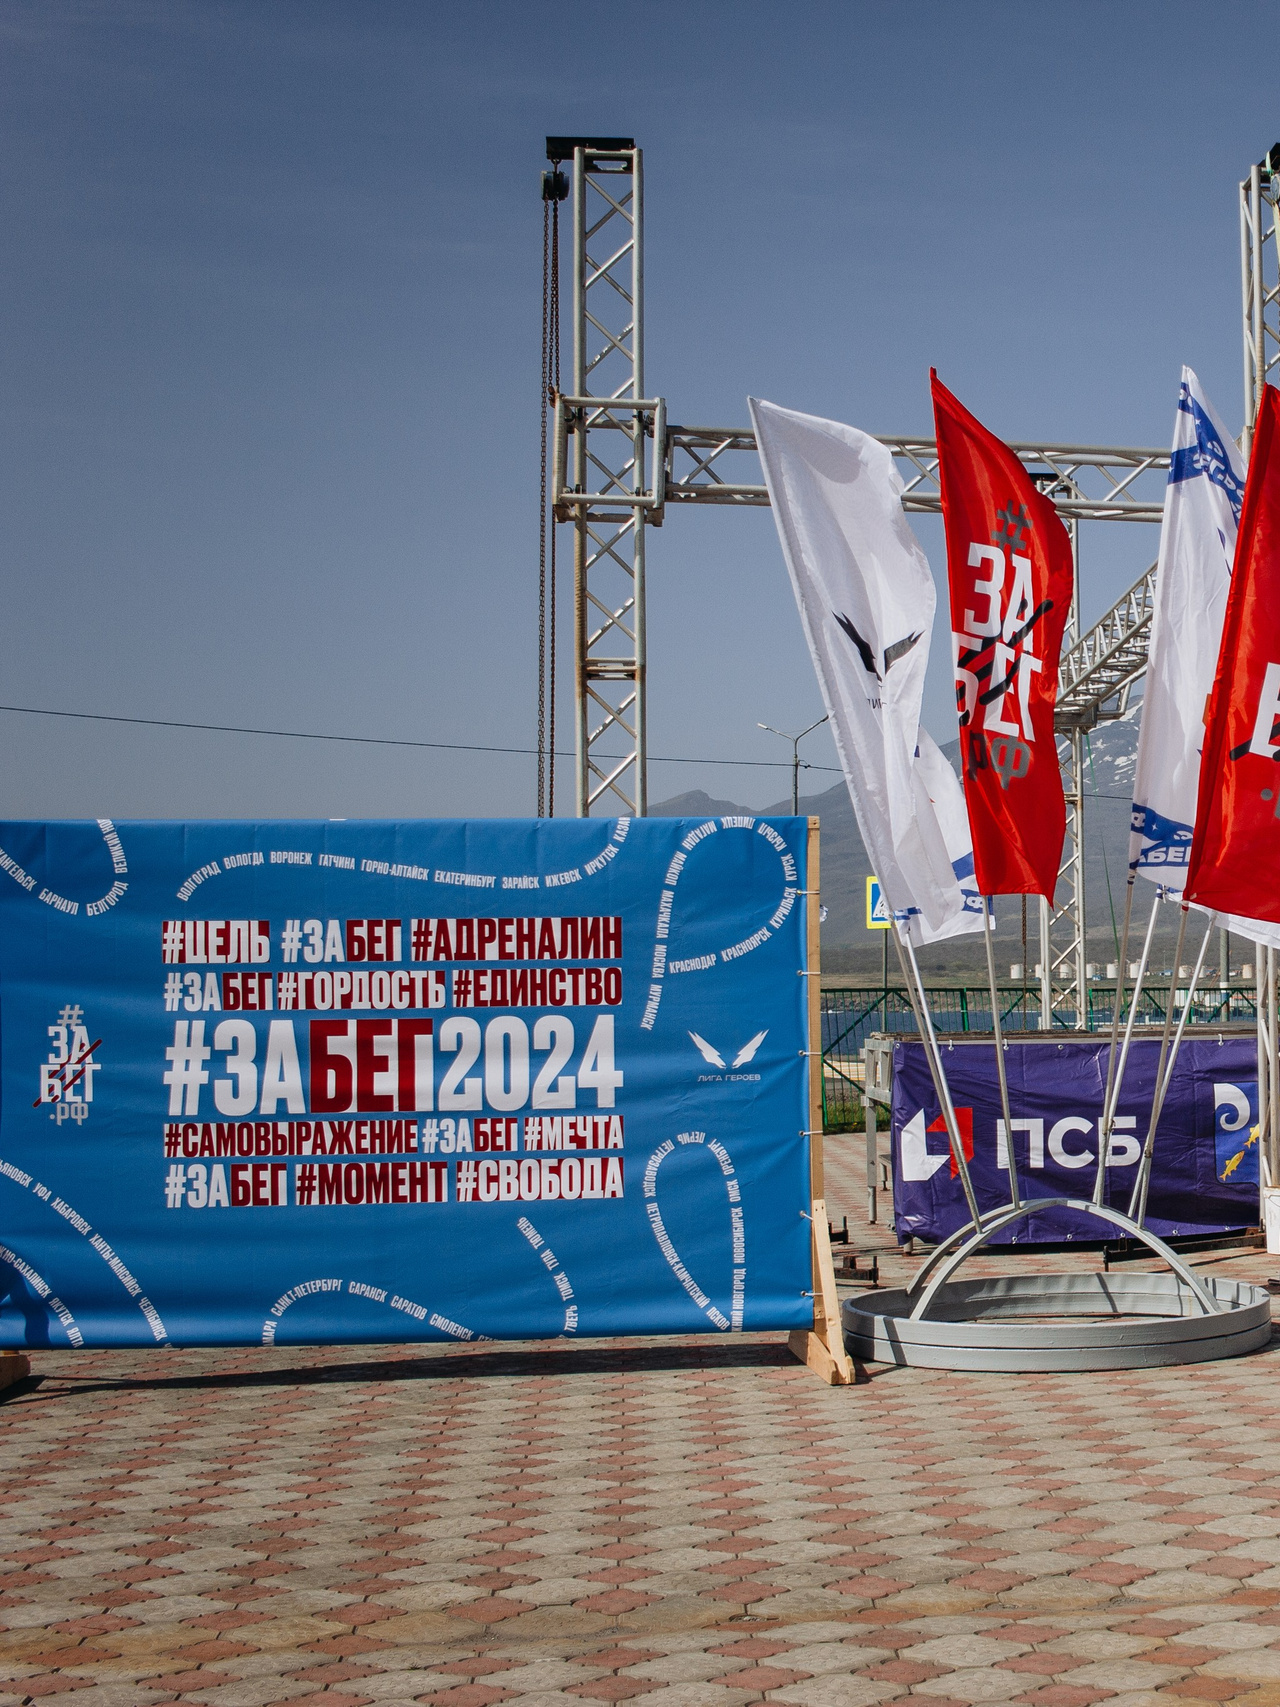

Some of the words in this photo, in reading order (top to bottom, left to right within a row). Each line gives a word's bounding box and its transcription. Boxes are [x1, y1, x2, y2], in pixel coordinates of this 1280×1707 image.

[964, 541, 1034, 652] ЗА
[681, 820, 717, 851] МАГАДАН
[720, 816, 756, 830] ЛИПЕЦК
[757, 822, 788, 852] КЫЗЫЛ
[103, 831, 128, 874] ВЕЛИКИЙ
[664, 850, 687, 886] МАЙКОП
[780, 853, 798, 881] КУРСК
[176, 861, 222, 902] ВОЛГОГРАД
[223, 851, 265, 870] ВОЛОГДА
[270, 851, 313, 865] ВОРОНЕЖ
[318, 854, 356, 870] ГАТЧИНА
[361, 859, 430, 881] ГОРНО-АЛТАЙСК
[434, 870, 497, 888] ЕКАТЕРИНБУРГ
[502, 875, 540, 889] ЗАРАЙСК
[545, 868, 582, 888] ИЖЕВСК
[584, 843, 620, 876] ИРКУТСК
[38, 888, 79, 915] БАРНАУЛ
[86, 881, 129, 916] БЕЛГОРОД
[656, 889, 675, 939] МАХАЧКАЛА
[769, 886, 798, 929] КУРИЛЬСК
[163, 920, 270, 963] #ЦЕЛЬ
[281, 919, 402, 963] #ЗАБЕГ
[411, 917, 622, 961] #АДРЕНАЛИН
[721, 926, 772, 962] КРАСНОЯРСК
[652, 944, 667, 978] МОСКВА
[669, 953, 717, 974] КРАСНОДАР
[164, 972, 273, 1011] #ЗАБЕГ
[277, 970, 446, 1010] #ГОРДОСТЬ
[452, 967, 622, 1008] #ЕДИНСТВО
[640, 984, 662, 1030] МУРМАНСК
[48, 1025, 94, 1064] ЗА
[40, 1063, 102, 1102] БЕГ
[163, 1014, 623, 1116] #ЗАБЕГ2024
[164, 1119, 417, 1158] #САМОВЫРАЖЕНИЕ
[422, 1117, 518, 1153] #ЗАБЕГ
[524, 1115, 623, 1151] #МЕЧТА
[677, 1131, 705, 1145] ПЕРМЬ
[997, 1116, 1141, 1169] ПСБ
[644, 1139, 675, 1198] ПЕТРОЗАВОДСК
[707, 1138, 735, 1176] ОРЕНБУРГ
[164, 1162, 287, 1208] #ЗАБЕГ
[296, 1161, 448, 1206] #МОМЕНТ
[456, 1157, 624, 1202] #СВОБОДА
[726, 1178, 741, 1202] ОМСК
[516, 1216, 545, 1250] ТЮМЕНЬ
[730, 1206, 745, 1264] НОВОСИБИРСК
[32, 1182, 53, 1202] УФА
[50, 1197, 93, 1236] ХАБАРОВСК
[88, 1233, 143, 1297] ХАНТЫ-МАНСИЙСК
[138, 1296, 168, 1342] ЧЕЛЯБИНСК
[540, 1248, 560, 1271] ТУЛА
[646, 1202, 711, 1309] ПЕТРОПАВЛОВСК-КАМЧАТСКИЙ
[553, 1271, 575, 1301] ТОМСК
[732, 1268, 746, 1309] НОВГОРОД
[48, 1297, 75, 1327] ЯКУТСК
[66, 1326, 85, 1348] ЯЛТА
[270, 1279, 343, 1317] САНКТ-ПЕТЕРБУРГ
[348, 1281, 388, 1303] САРАНСК
[390, 1295, 428, 1320] САРАТОВ
[429, 1313, 475, 1340] СМОЛЕНСК
[564, 1305, 578, 1332] ТВЕРЬ
[706, 1306, 730, 1331] ПСКОВ
